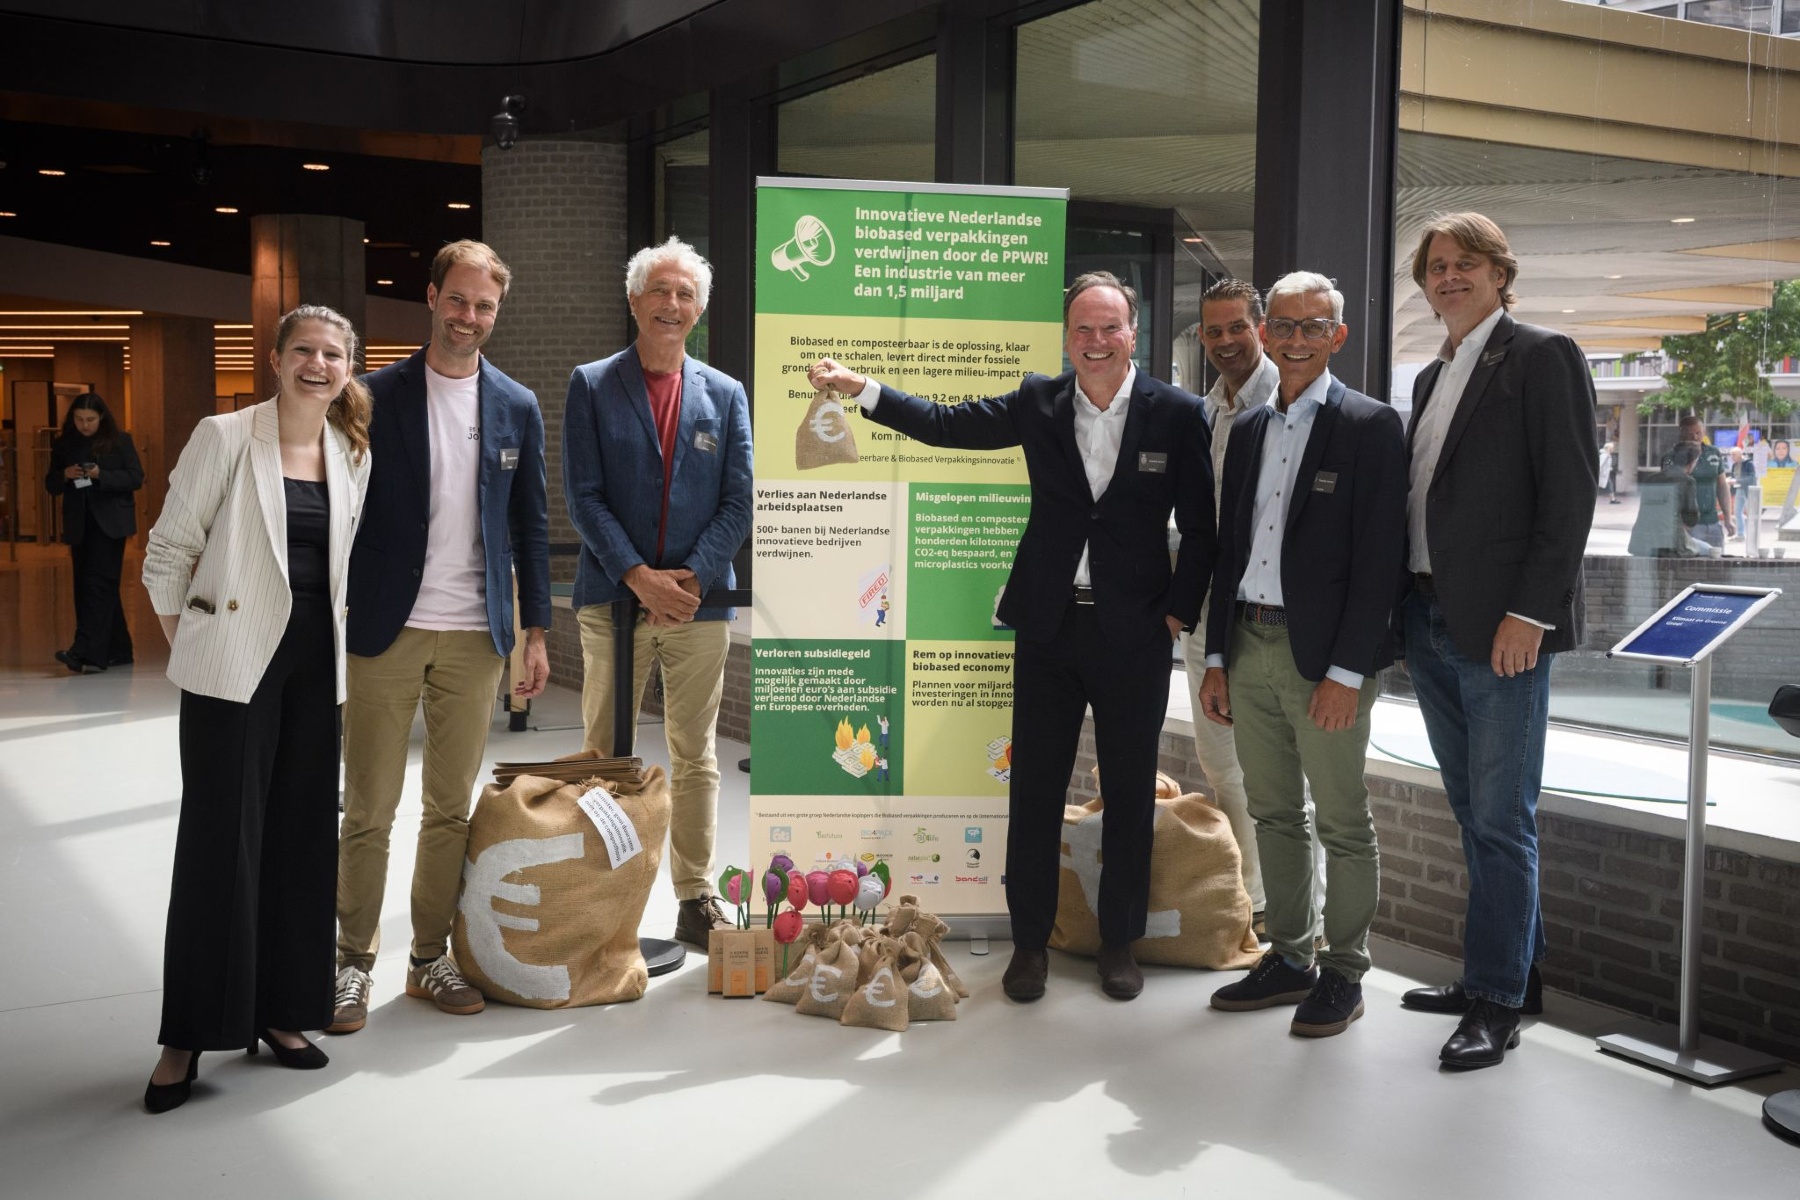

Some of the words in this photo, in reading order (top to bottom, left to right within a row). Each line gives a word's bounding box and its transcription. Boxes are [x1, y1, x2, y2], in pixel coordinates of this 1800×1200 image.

[856, 207, 944, 222] Innovatieve
[949, 210, 1042, 226] Nederlandse
[855, 226, 922, 241] biobased
[926, 229, 1028, 246] verpakkingen
[855, 247, 939, 263] verdwijnen
[943, 249, 977, 262] door
[981, 250, 998, 262] de
[1003, 251, 1048, 265] PPWR!
[854, 266, 880, 278] Een
[885, 266, 951, 279] industrie
[956, 270, 983, 281] van
[987, 271, 1025, 282] meer
[854, 284, 882, 296] dan
[887, 286, 906, 300] 1,5
[911, 286, 964, 302] miljard
[790, 336, 834, 346] Biobased
[851, 338, 930, 350] composteerbaar
[932, 340, 940, 348] is
[942, 340, 954, 349] de
[956, 341, 1003, 353] oplossing,
[1006, 342, 1030, 351] klaar
[832, 352, 843, 360] te
[845, 351, 884, 362] schalen,
[887, 352, 914, 362] levert
[917, 353, 945, 362] direct
[947, 353, 982, 364] minder
[984, 355, 1020, 365] fossiele
[923, 366, 952, 377] lagere
[955, 366, 1020, 379] milieu-impact
[932, 393, 946, 402] 9.2
[871, 432, 892, 441] Kom
[899, 455, 933, 463] Biobased
[935, 455, 1014, 466] Verpakkingsinnovatie
[757, 490, 794, 499] Verlies
[820, 491, 886, 500] Nederlandse
[916, 492, 976, 503] Misgelopen
[979, 494, 1030, 503] milieuwin
[757, 503, 843, 514] arbeidsplaatsen
[916, 513, 959, 522] Biobased
[976, 514, 1030, 526] compostee
[756, 526, 778, 534] 500+
[782, 526, 812, 534] banen
[814, 526, 826, 538] bij
[830, 526, 890, 536] Nederlandse
[915, 526, 980, 536] verpakkingen
[983, 526, 1018, 535] hebben
[756, 538, 813, 546] innovatieve
[816, 538, 862, 549] bedrijven
[915, 537, 967, 546] honderden
[756, 549, 813, 560] verdwijnen.
[915, 548, 948, 560] CO2-eq
[952, 549, 998, 559] bespaard,
[914, 560, 978, 571] microplastics
[980, 561, 1012, 570] voorko
[860, 576, 886, 605] FIRED
[1685, 605, 1733, 615] Commissie
[755, 649, 802, 658] Verloren
[804, 649, 870, 660] subsidiegeld
[913, 650, 936, 660] Rem
[939, 652, 952, 662] op
[955, 650, 1016, 660] innovatieve
[755, 668, 805, 676] Innovaties
[808, 668, 825, 678] zijn
[828, 668, 854, 676] mede
[913, 662, 960, 672] biobased
[963, 665, 1010, 674] economy
[755, 676, 796, 686] mogelijk
[798, 677, 840, 686] gemaakt
[844, 677, 866, 685] door
[912, 681, 952, 690] Plannen
[978, 680, 1015, 692] miljard
[755, 685, 803, 696] miljoenen
[858, 686, 897, 694] subsidie
[912, 690, 978, 700] investeringen
[980, 690, 989, 698] in
[755, 694, 797, 703] verleend
[800, 694, 822, 702] door
[824, 694, 885, 703] Nederlandse
[912, 699, 949, 707] worden
[966, 699, 974, 707] al
[977, 700, 1013, 709] stopgez
[769, 703, 813, 713] Europese
[816, 703, 869, 712] overheden.
